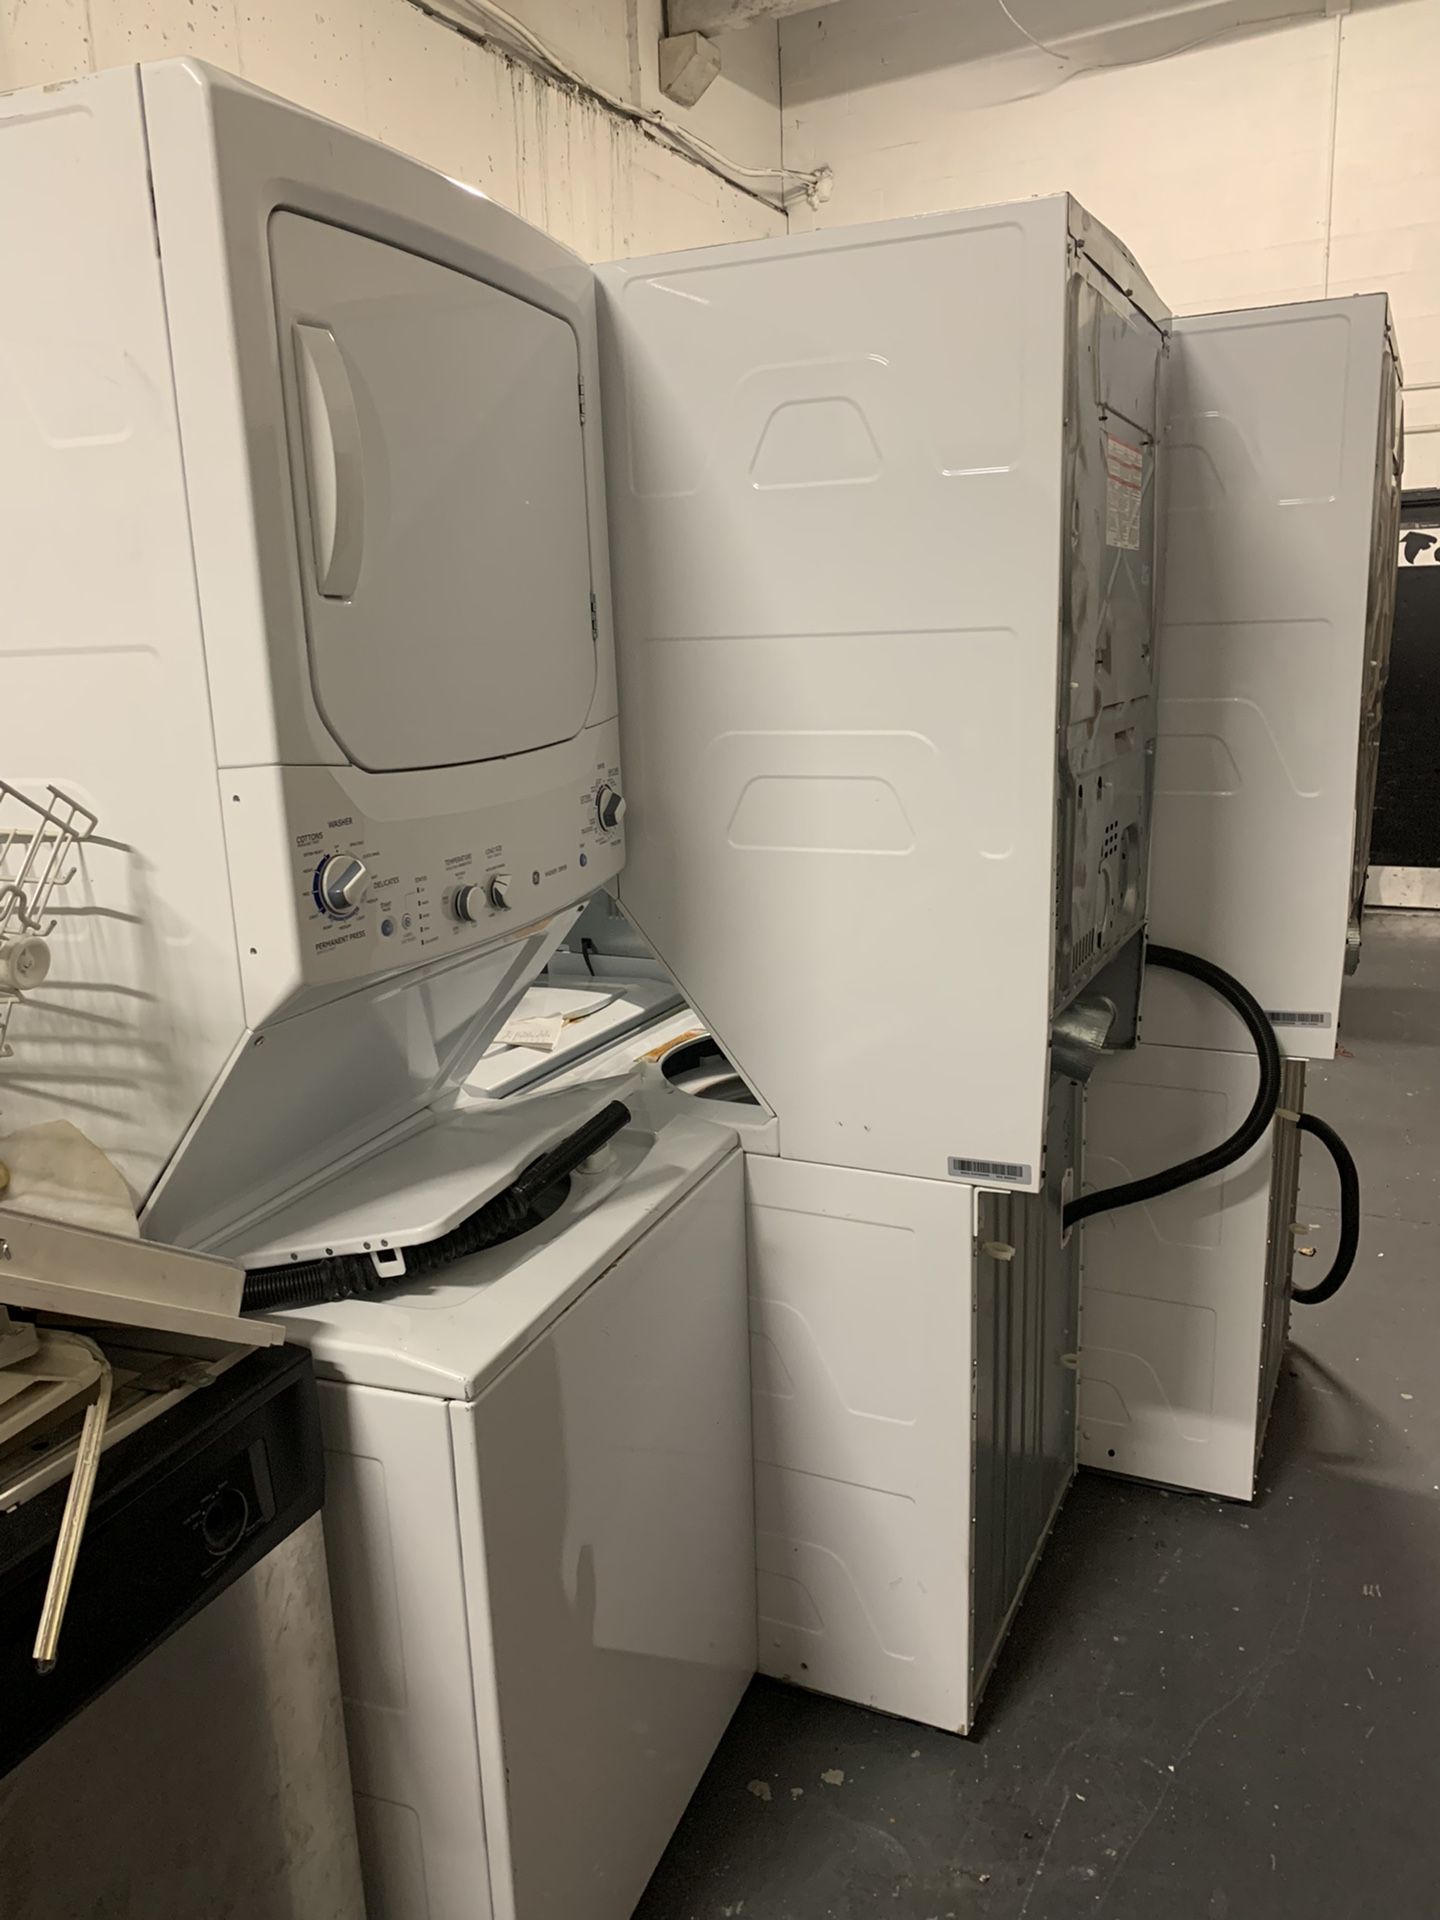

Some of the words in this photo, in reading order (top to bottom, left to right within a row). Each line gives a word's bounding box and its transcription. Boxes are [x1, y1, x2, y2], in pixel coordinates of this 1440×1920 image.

[328, 817, 353, 828] WASHER
[296, 832, 323, 844] COTTONS
[373, 877, 399, 888] DELICATES
[315, 934, 349, 950] PERMANENT
[349, 930, 366, 940] PRESS
